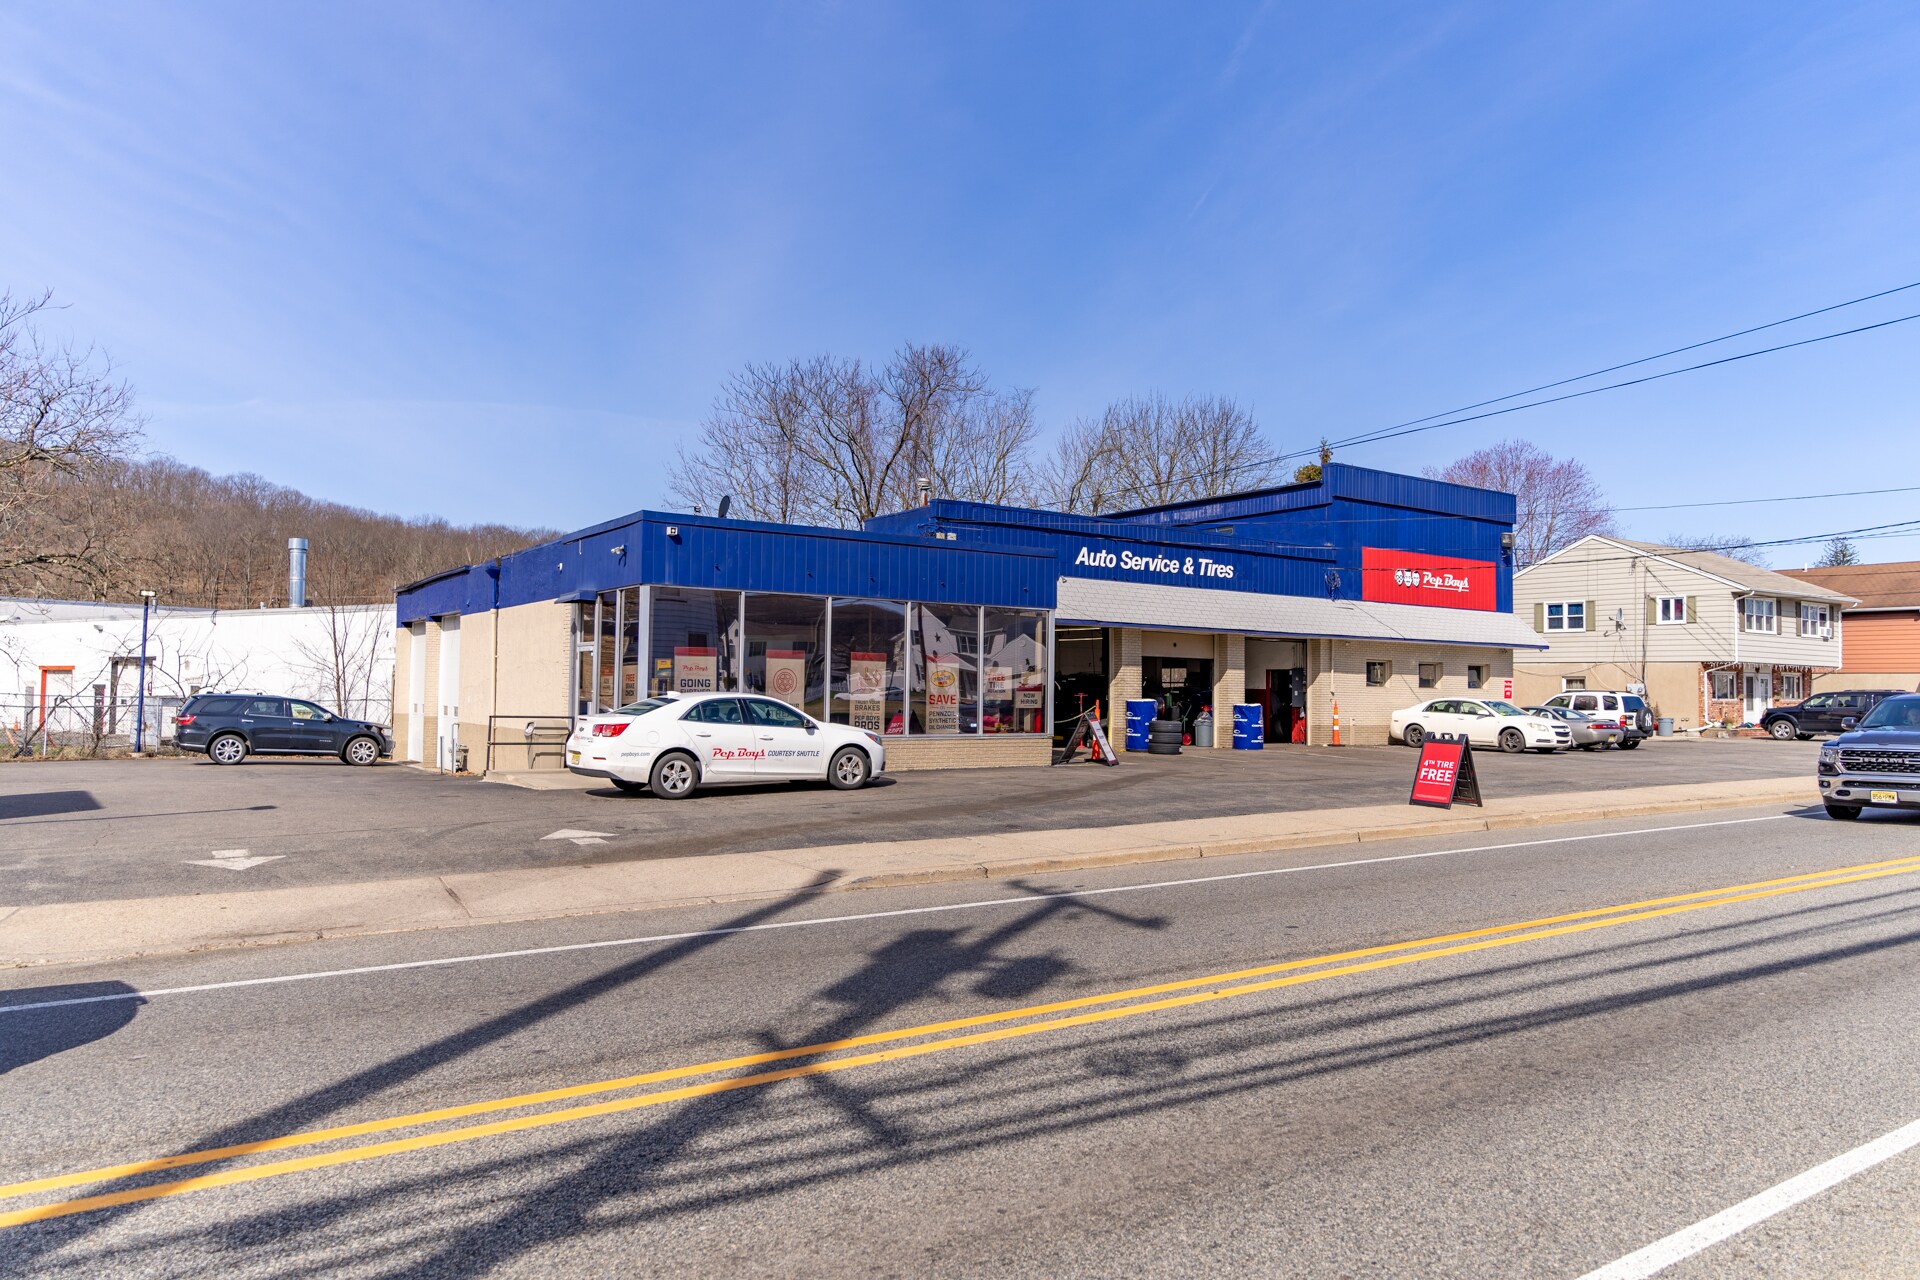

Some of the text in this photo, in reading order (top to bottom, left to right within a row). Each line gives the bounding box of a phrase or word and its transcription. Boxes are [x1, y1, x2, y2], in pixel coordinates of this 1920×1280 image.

[1075, 546, 1234, 579] Auto Service & Tires
[1422, 571, 1469, 593] Pep Boys
[682, 664, 708, 672] Pep Boys
[680, 678, 711, 688] GOING
[988, 681, 1005, 689] TIRE
[928, 694, 957, 705] SAVE
[854, 721, 880, 730] PROS
[712, 747, 736, 760] Pep
[737, 747, 766, 760] Boys
[1436, 760, 1455, 769] TIRE
[1420, 767, 1454, 782] FREE
